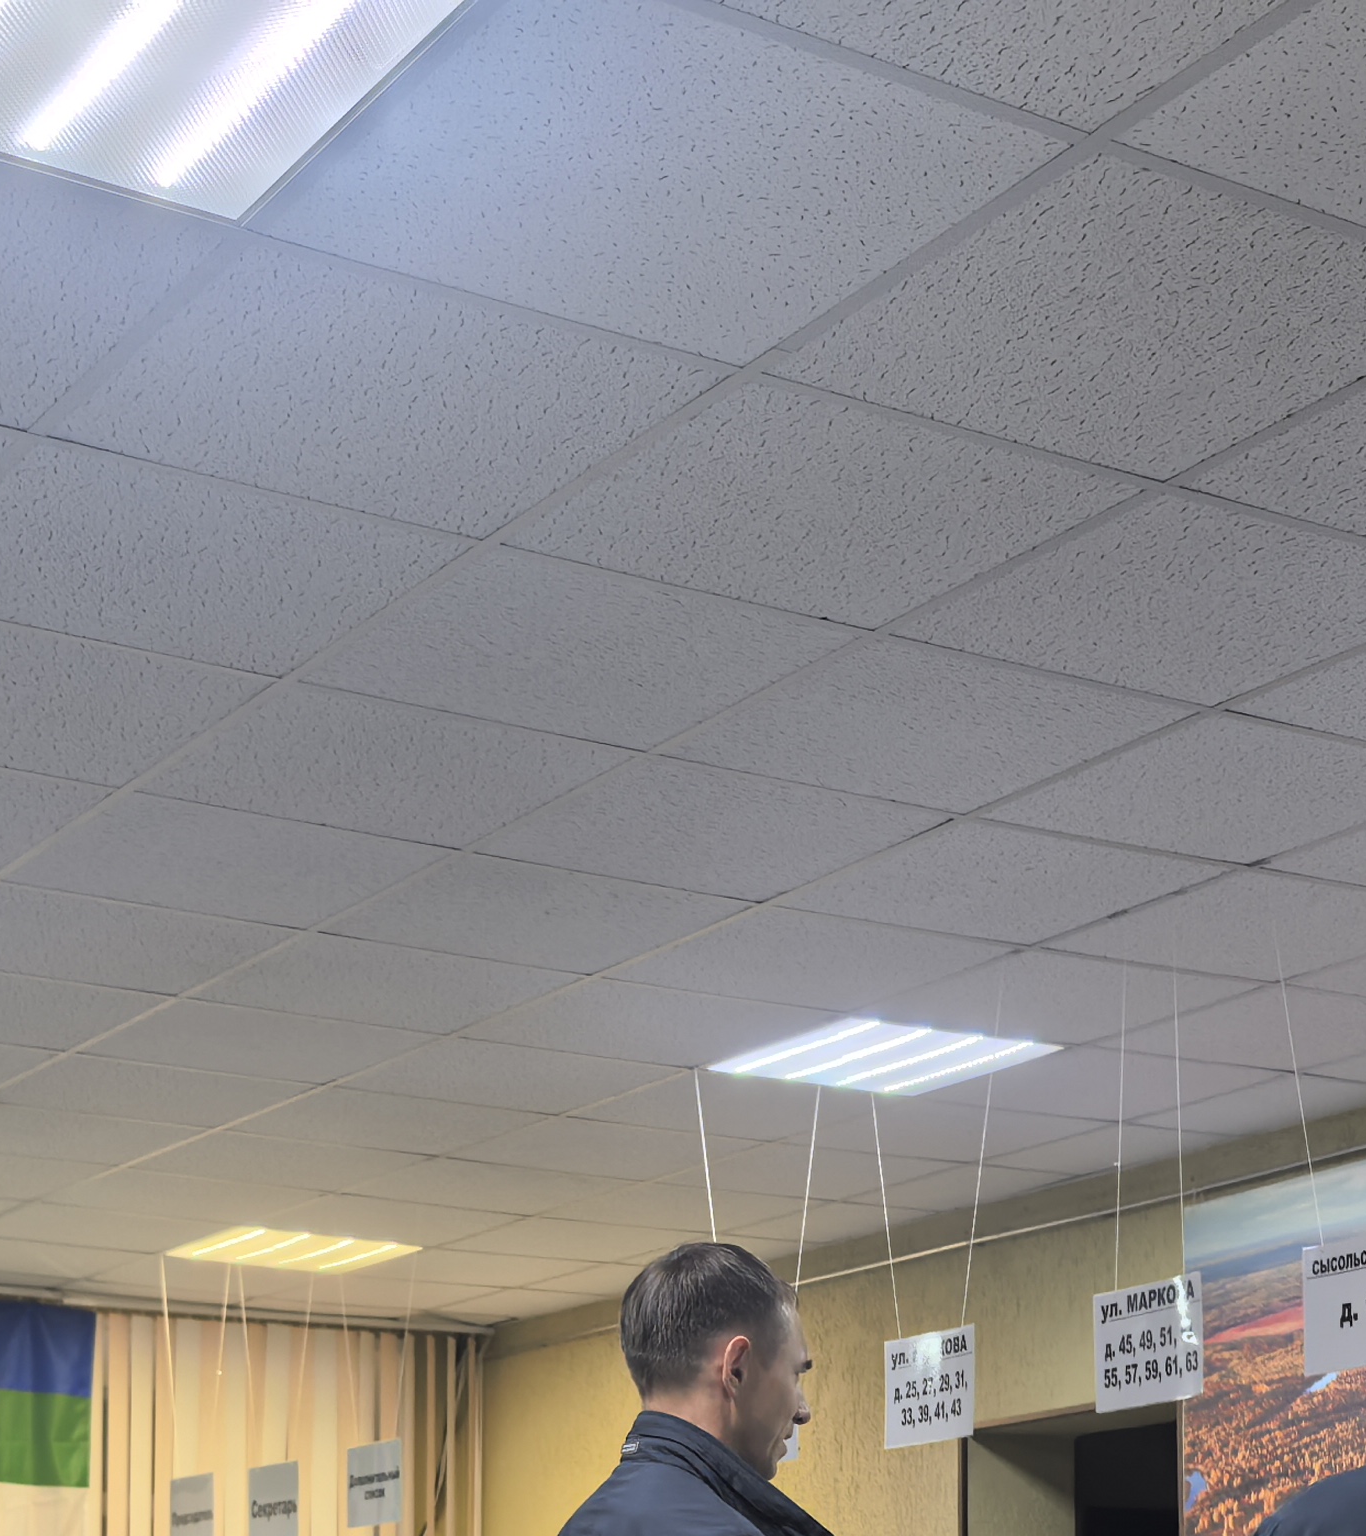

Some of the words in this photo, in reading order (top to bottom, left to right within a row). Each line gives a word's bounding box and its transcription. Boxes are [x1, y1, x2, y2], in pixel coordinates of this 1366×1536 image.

[1101, 1302, 1122, 1324] ул.
[1127, 1280, 1195, 1314] МАРКОА
[1340, 1303, 1358, 1328] д.
[1105, 1343, 1115, 1362] д.
[1118, 1333, 1136, 1357] 45,
[1139, 1329, 1156, 1353] 49,
[1159, 1325, 1176, 1349] 51,
[891, 1352, 908, 1370] ул.
[1104, 1367, 1121, 1391] 55,
[1125, 1363, 1141, 1387] 57,
[1145, 1359, 1161, 1382] 59,
[1165, 1355, 1182, 1378] 61,
[1185, 1350, 1198, 1372] 63
[894, 1387, 903, 1404] д.
[905, 1381, 920, 1400] 25,
[939, 1373, 952, 1396] 29,
[955, 1369, 968, 1391] 31,
[901, 1407, 915, 1428] 33,
[918, 1404, 931, 1425] 39,
[934, 1401, 948, 1422] 41,
[951, 1398, 962, 1417] 43
[251, 1499, 297, 1521] Секретарь
